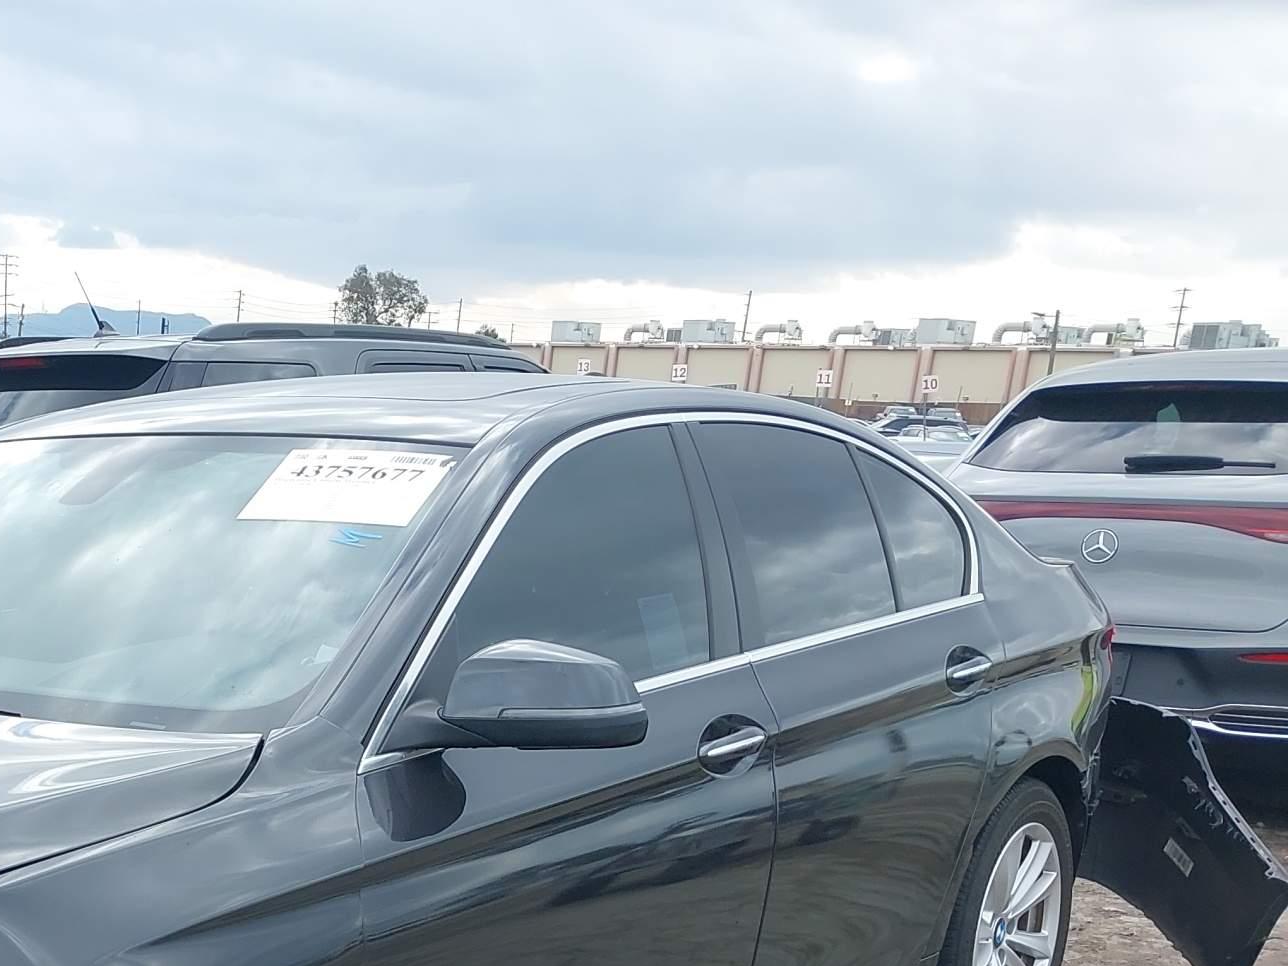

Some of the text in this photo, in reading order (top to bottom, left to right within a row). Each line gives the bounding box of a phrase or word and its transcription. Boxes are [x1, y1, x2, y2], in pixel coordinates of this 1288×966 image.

[578, 362, 590, 372] 13
[673, 368, 686, 378] 12
[817, 374, 831, 384] 11
[923, 379, 937, 390] 10
[290, 465, 425, 482] 43757677
